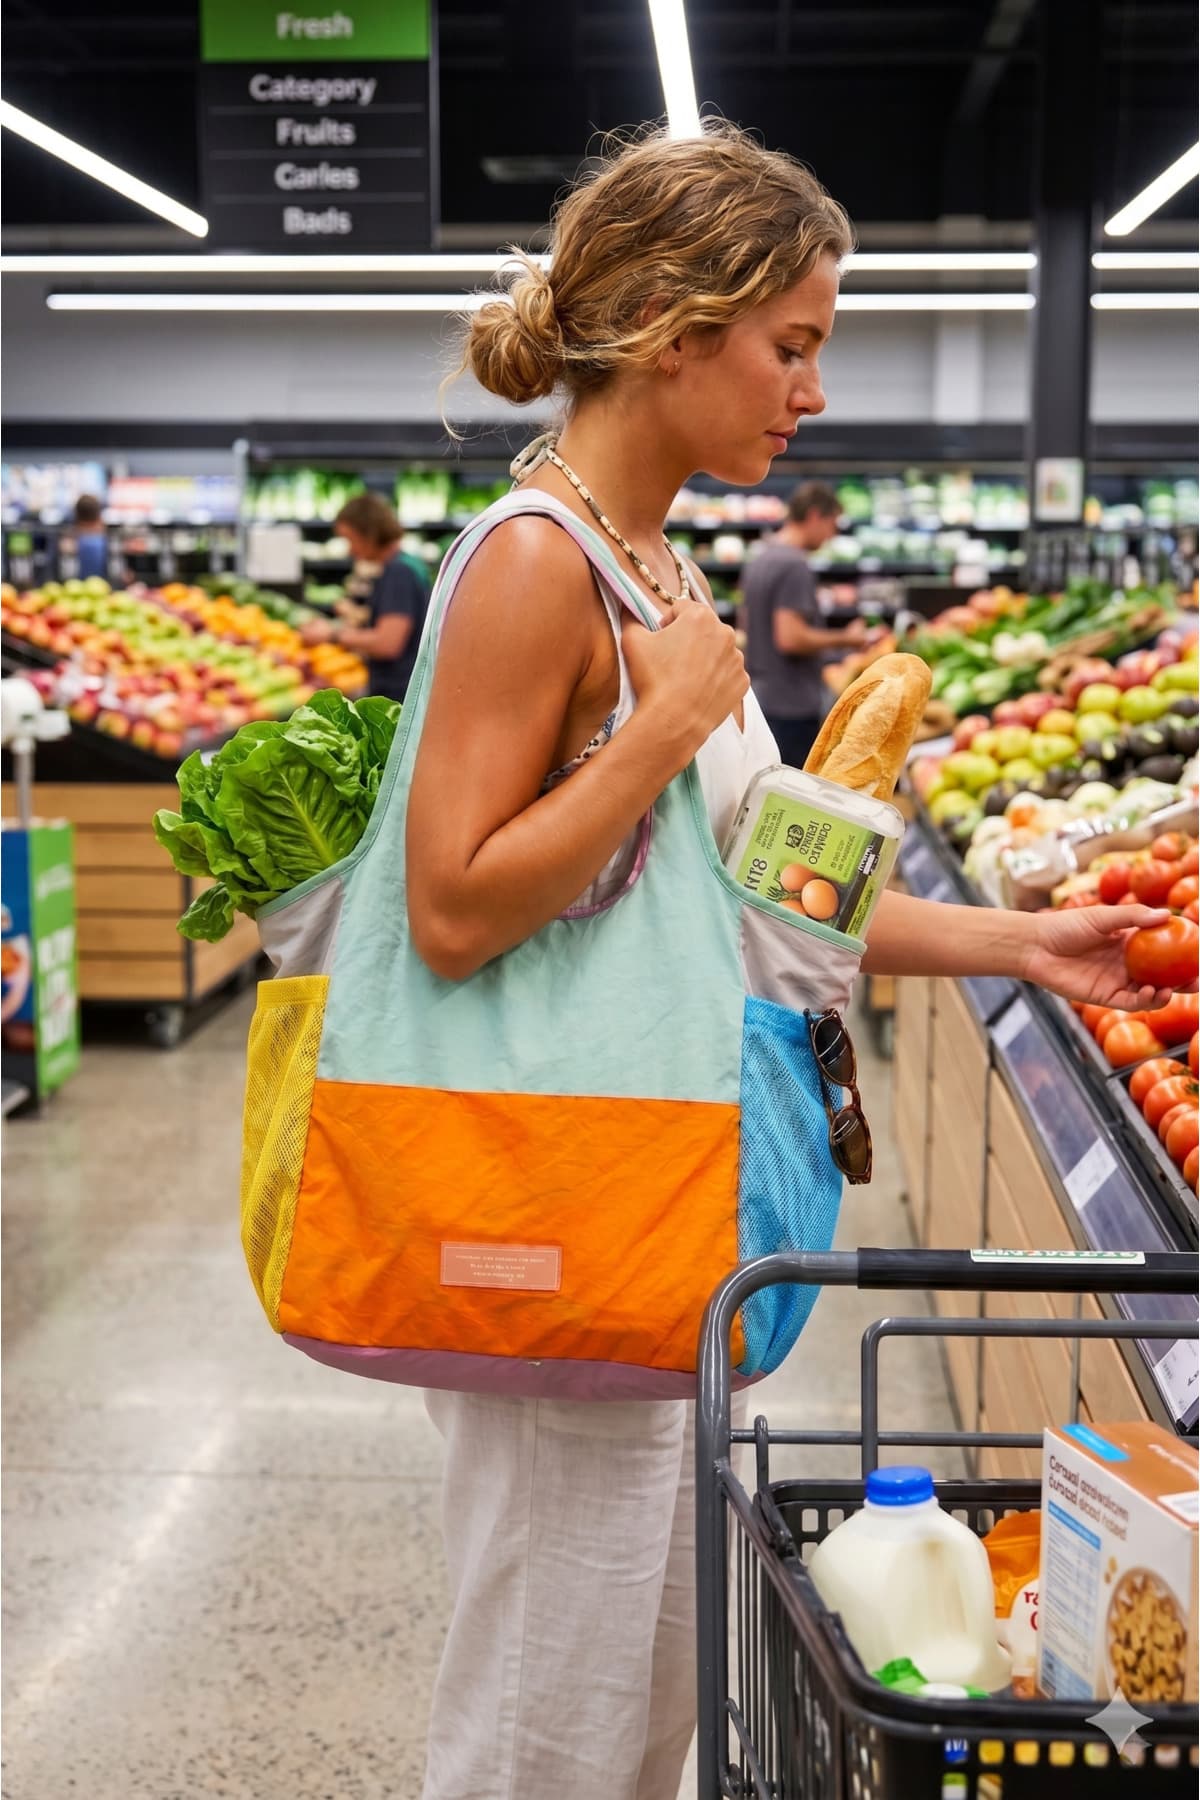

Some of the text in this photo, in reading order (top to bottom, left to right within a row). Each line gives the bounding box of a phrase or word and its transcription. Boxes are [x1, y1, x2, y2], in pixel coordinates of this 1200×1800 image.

[276, 11, 354, 39] Fresh
[249, 74, 377, 107] Category
[276, 117, 356, 145] Fruits
[283, 206, 352, 235] Bads
